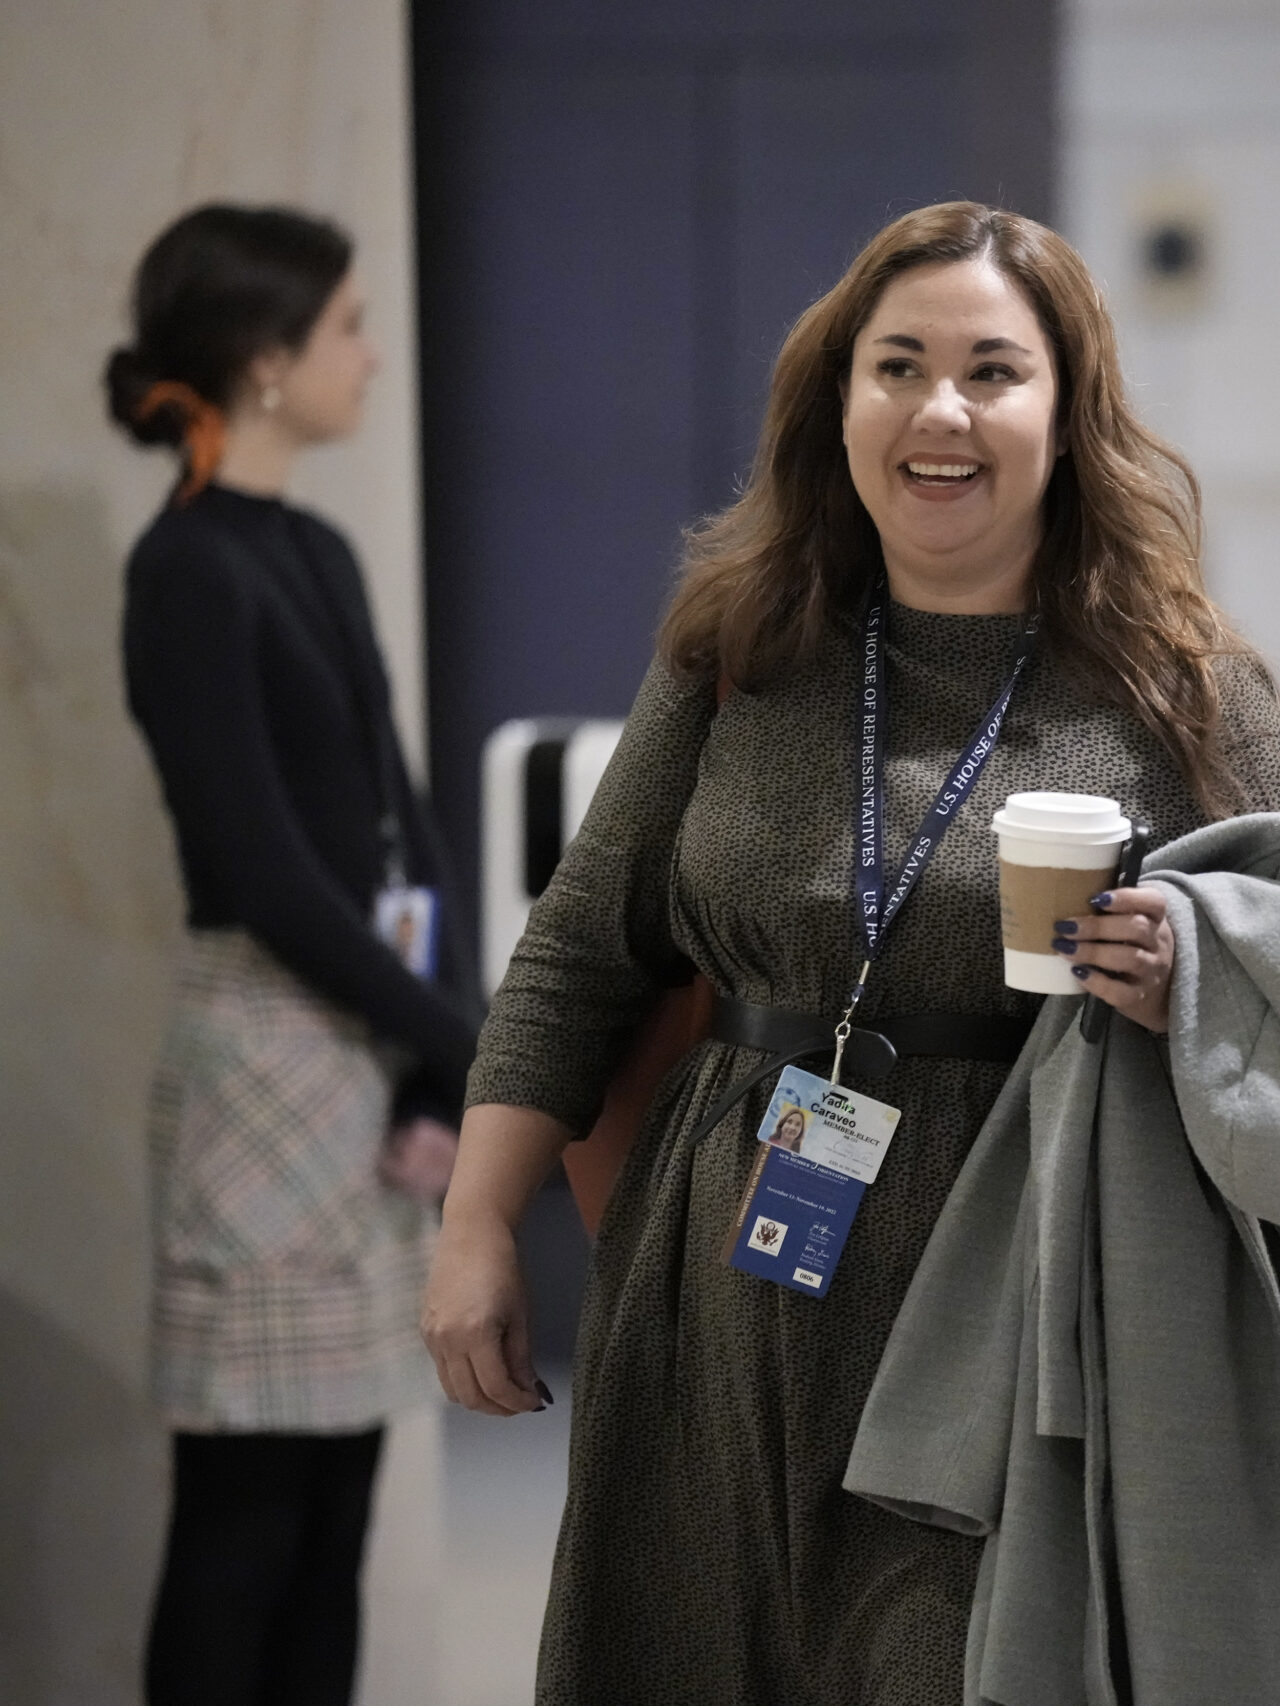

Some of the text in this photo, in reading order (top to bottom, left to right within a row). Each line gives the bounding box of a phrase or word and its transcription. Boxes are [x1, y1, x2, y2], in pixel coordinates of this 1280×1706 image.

[864, 631, 878, 685] HOUSE
[863, 688, 877, 708] OF
[935, 792, 959, 817] U.S.
[952, 736, 991, 791] HOUSE
[861, 714, 876, 867] REPRESENTATIVES
[862, 890, 878, 917] U.S.
[811, 1103, 857, 1128] Caraveo
[822, 1092, 856, 1115] Yadira
[823, 1120, 881, 1147] MEMBER-ELECT
